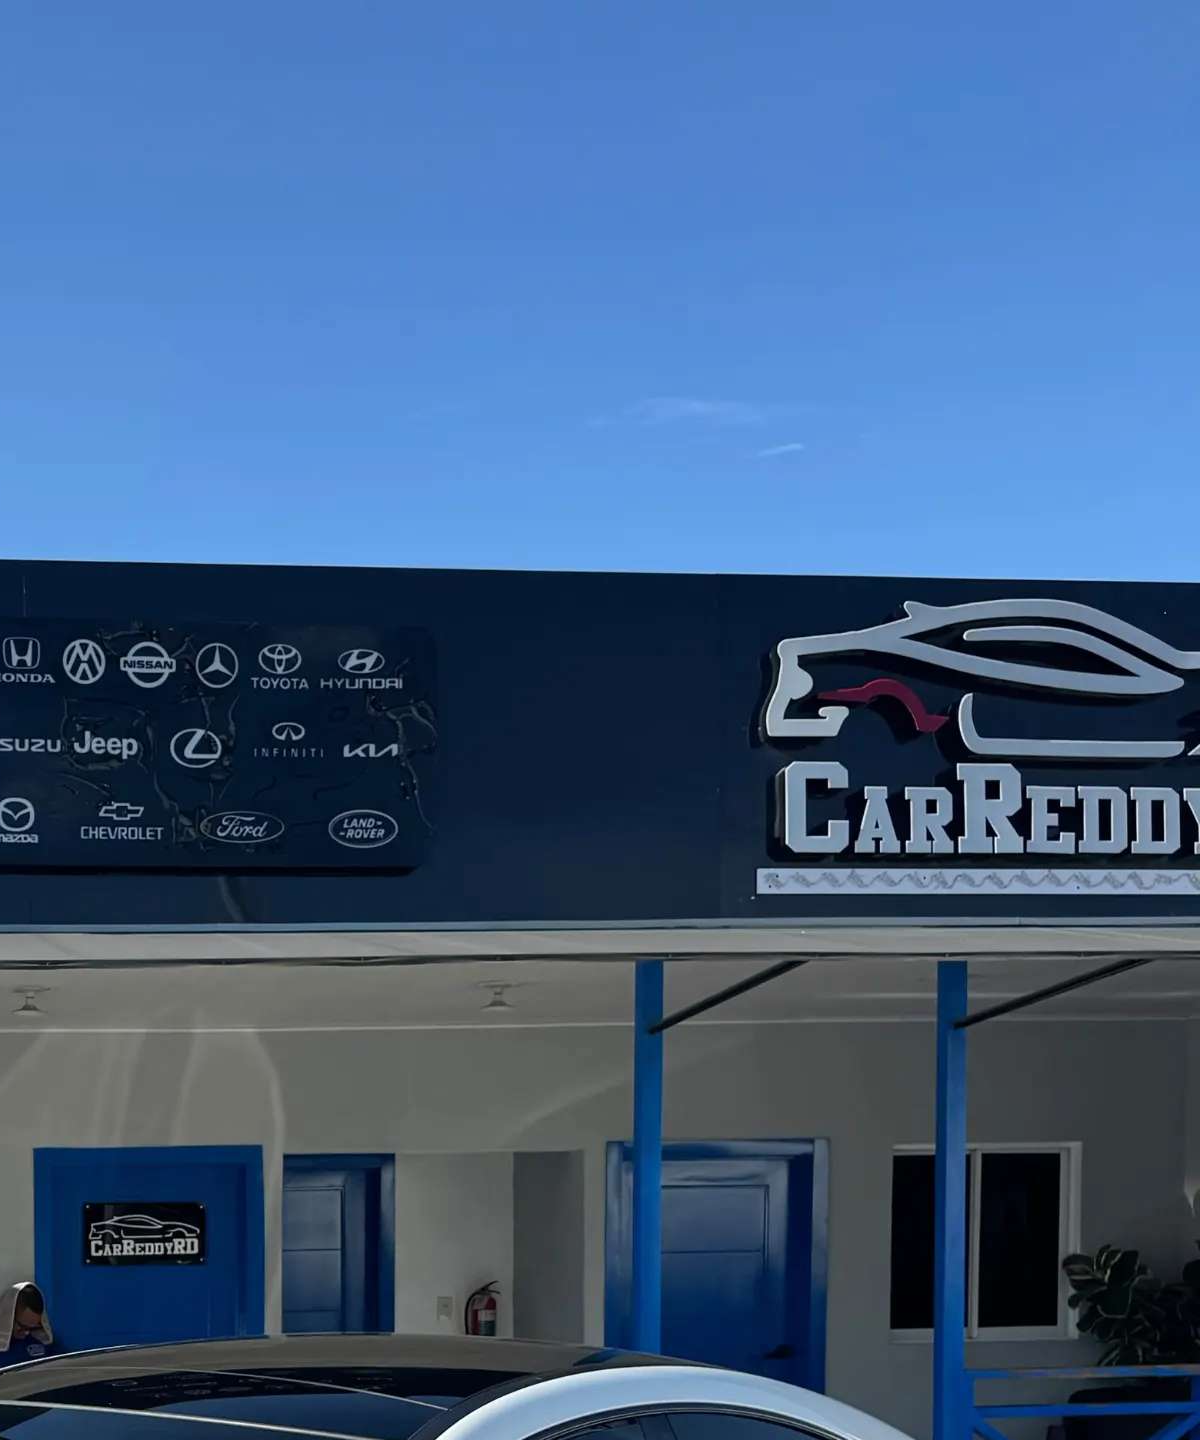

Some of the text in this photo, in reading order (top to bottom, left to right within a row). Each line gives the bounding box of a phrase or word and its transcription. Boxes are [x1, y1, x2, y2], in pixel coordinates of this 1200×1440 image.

[122, 659, 175, 670] NISSAN
[250, 676, 310, 690] TOYOTA
[320, 677, 403, 689] HYUNDAI
[73, 731, 138, 760] Jeep
[343, 743, 399, 758] KIA
[253, 747, 324, 759] INFINITI
[80, 826, 164, 840] CHEVROLET
[216, 815, 268, 837] Ford
